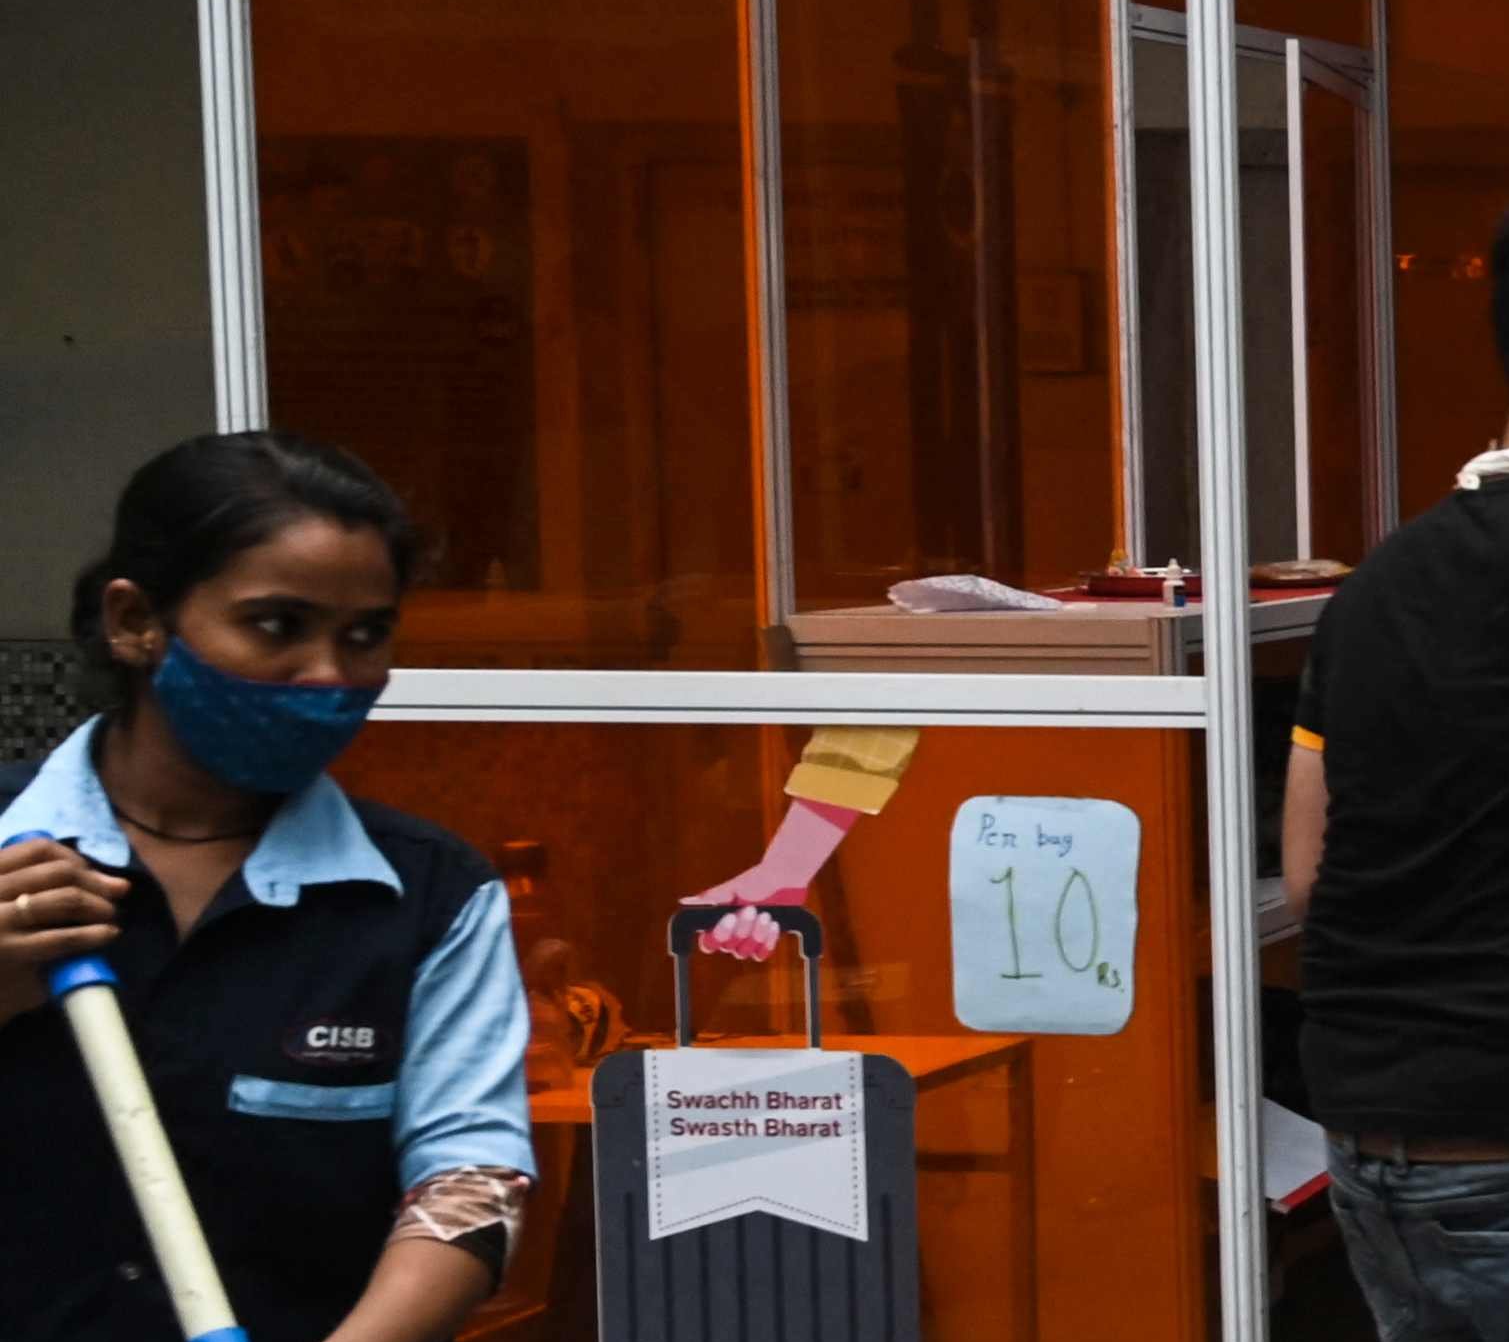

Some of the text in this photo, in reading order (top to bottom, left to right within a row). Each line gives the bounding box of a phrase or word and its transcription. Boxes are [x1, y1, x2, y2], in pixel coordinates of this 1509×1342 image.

[307, 1025, 375, 1048] CISB
[666, 1090, 844, 1112] Swachh Bharat
[669, 1117, 842, 1139] Swasth Bharat
